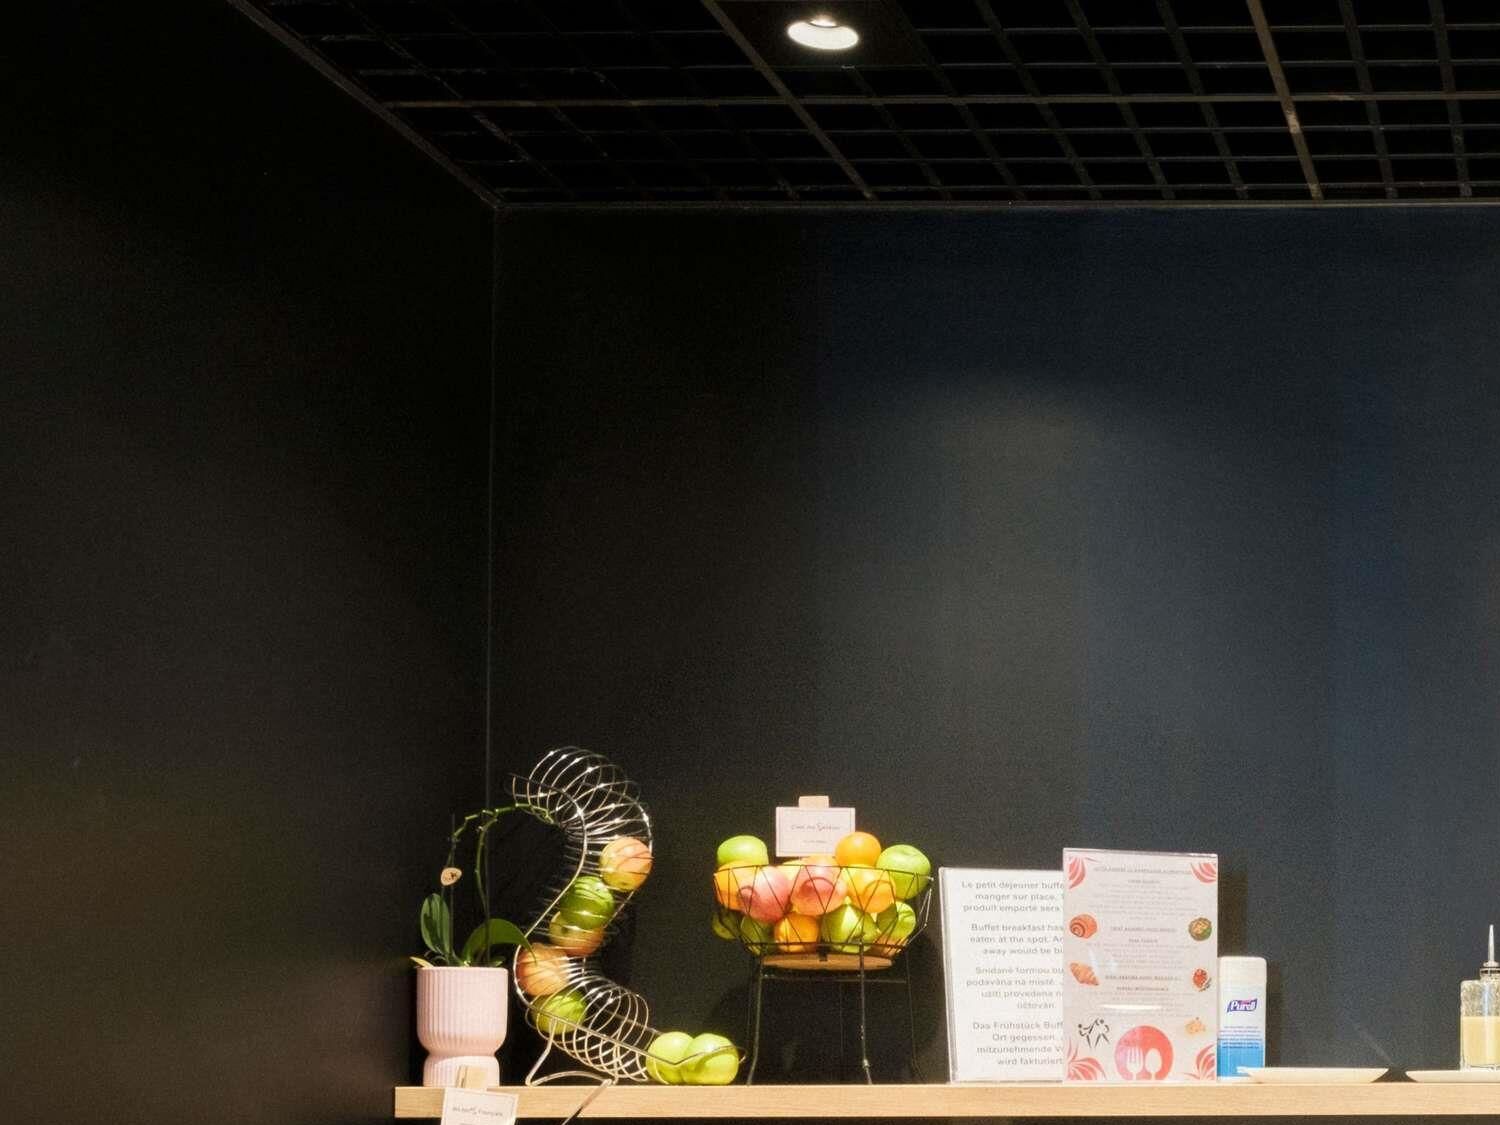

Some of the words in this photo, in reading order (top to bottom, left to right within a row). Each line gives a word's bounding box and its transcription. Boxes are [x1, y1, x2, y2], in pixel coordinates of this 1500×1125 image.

[961, 881, 973, 889] Le
[976, 881, 996, 890] petit
[975, 894, 1010, 902] manger
[963, 904, 997, 913] produit
[971, 923, 1000, 931] Buffet
[1002, 923, 1046, 931] breakfast
[1010, 935, 1024, 943] the
[984, 948, 1007, 956] away
[972, 1021, 991, 1030] Das
[992, 1033, 1007, 1041] Ort
[998, 1057, 1018, 1065] wird
